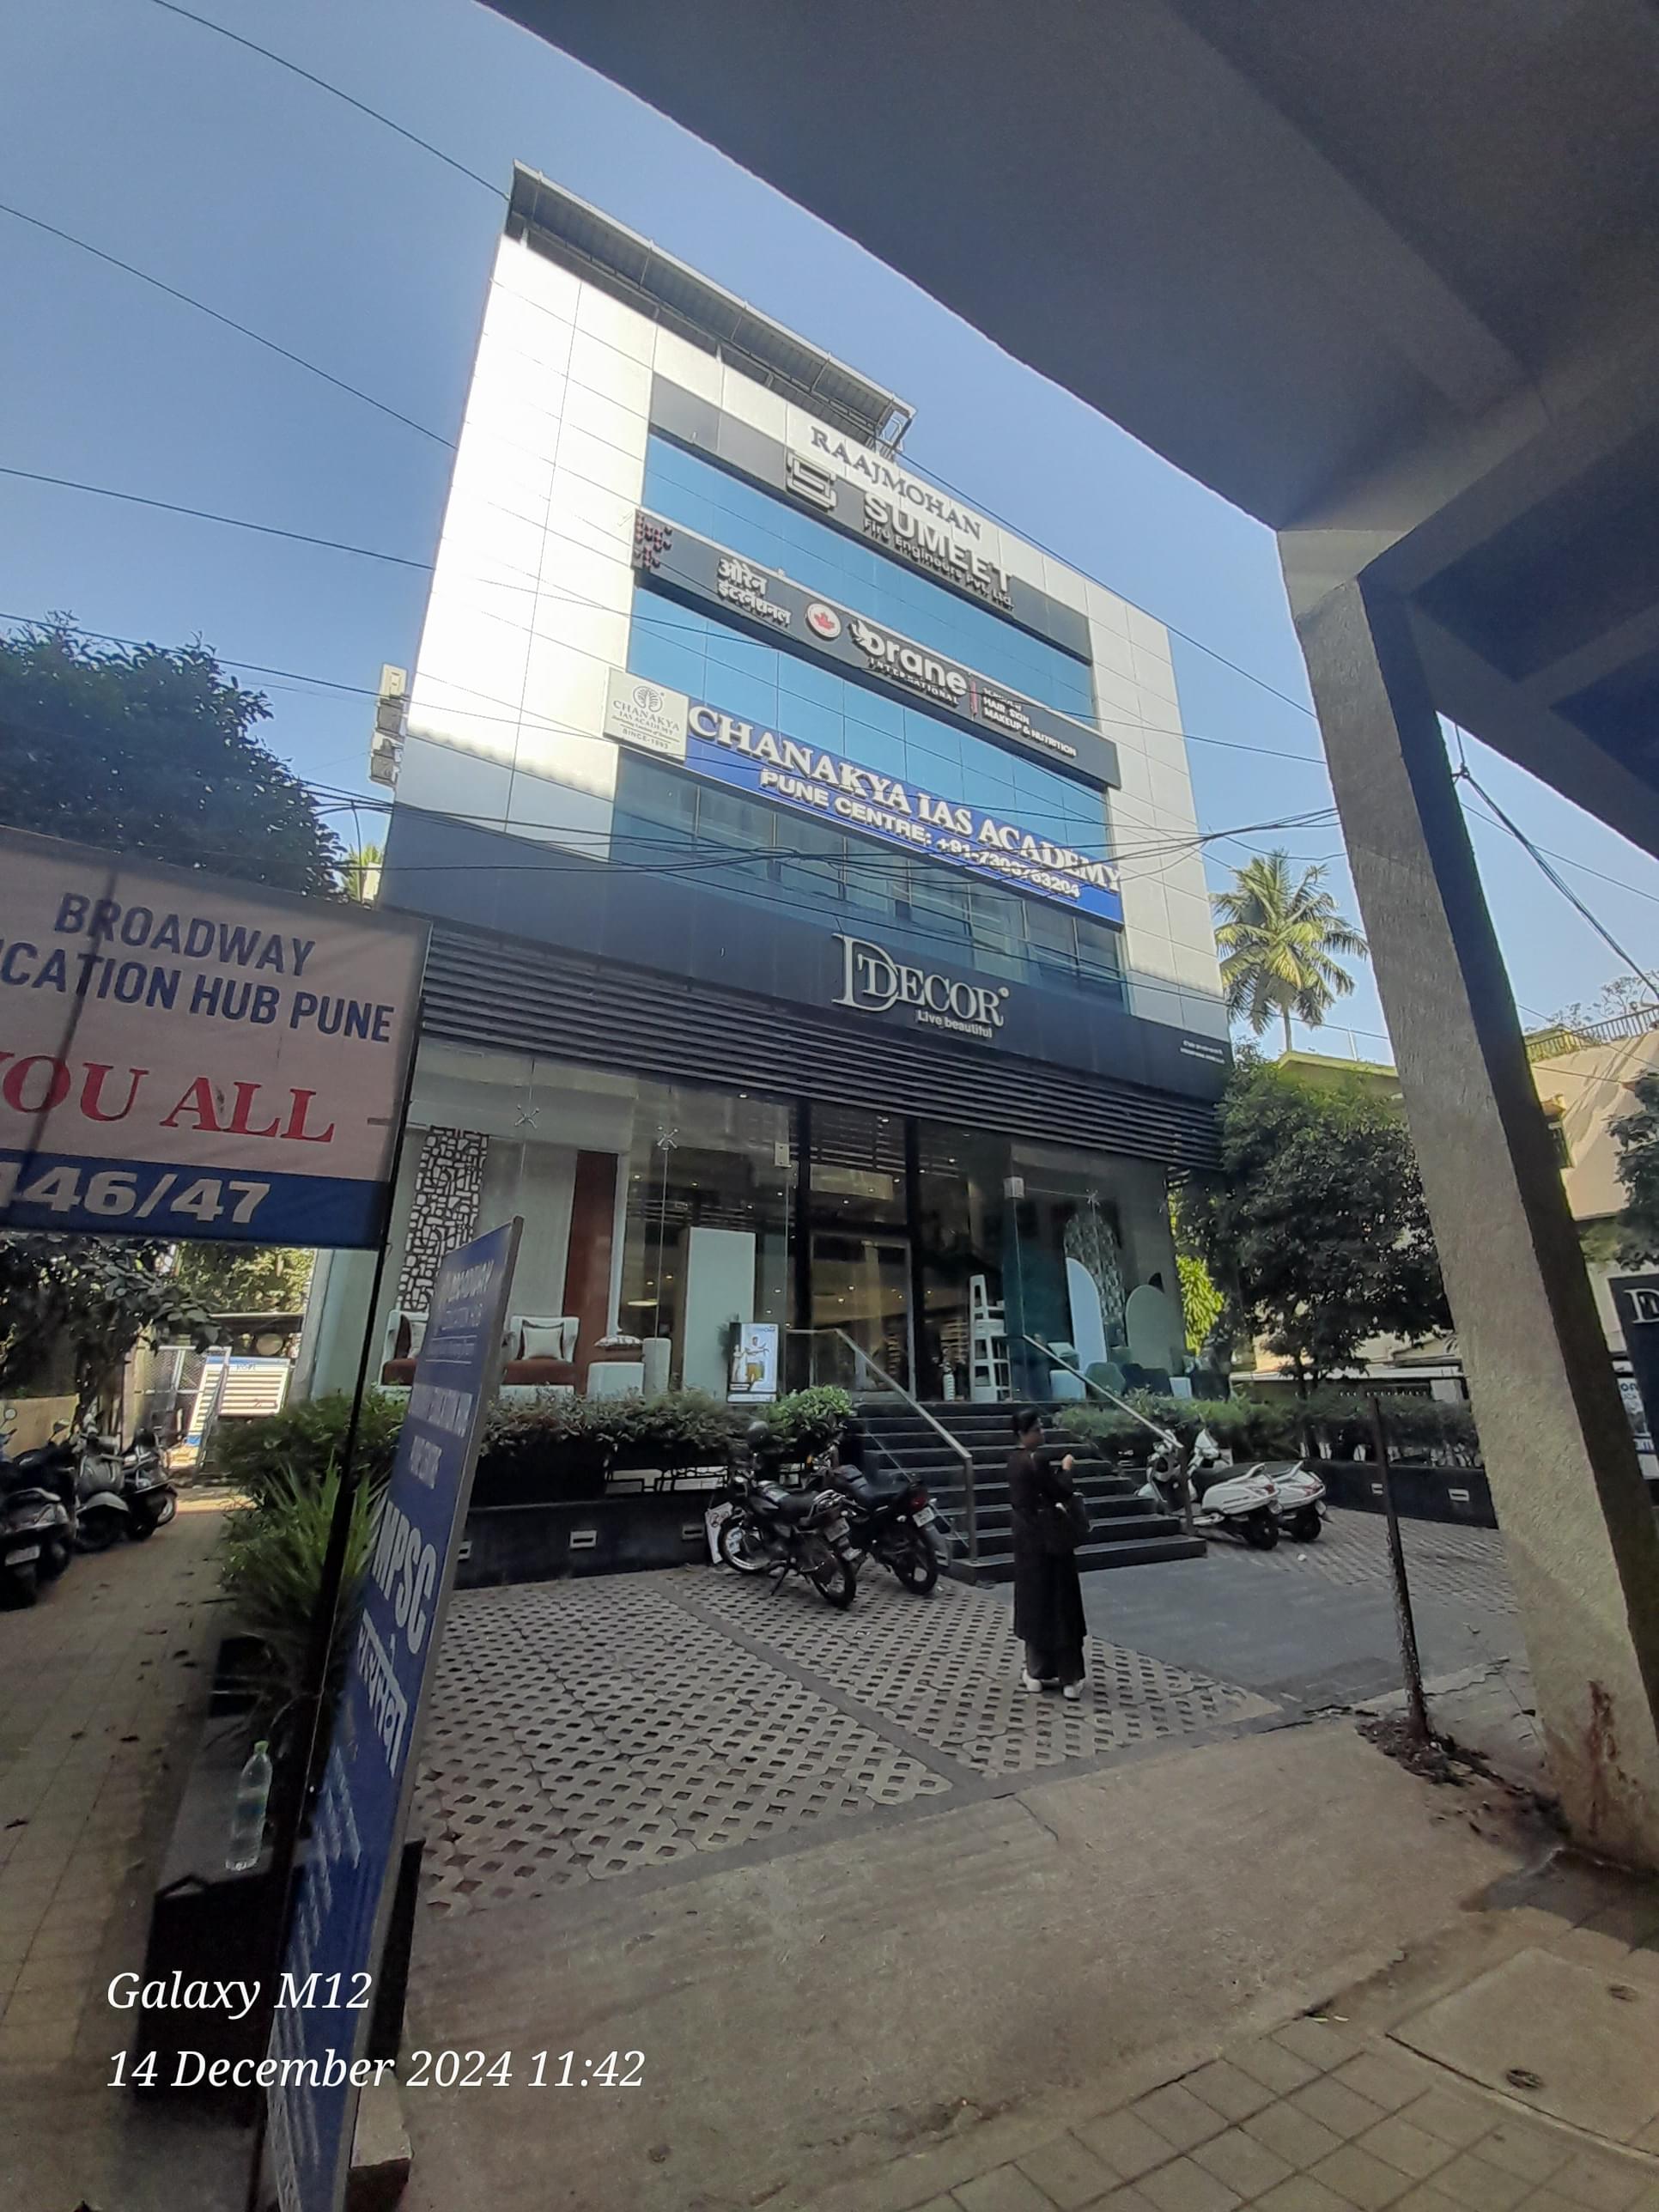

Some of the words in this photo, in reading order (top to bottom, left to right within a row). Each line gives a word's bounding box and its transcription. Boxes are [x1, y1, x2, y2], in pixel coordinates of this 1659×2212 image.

[811, 426, 981, 540] RAAJMOHAN
[864, 491, 1013, 592] SUMEET
[613, 700, 679, 732] CHANAKYA
[984, 707, 1022, 730] MAKEUP
[689, 705, 911, 815] CHANAKYA
[916, 792, 973, 836] IAS
[978, 819, 1121, 893] ACADEMY
[761, 769, 830, 807] PUNE
[834, 795, 932, 845] CENTRE:
[54, 892, 316, 977] BROADWAY
[0, 939, 181, 1010] CATION
[189, 974, 281, 1025] HUB
[289, 990, 395, 1043] PUNE
[917, 1009, 943, 1025] Live
[944, 1017, 993, 1038] beautiful
[160, 1076, 336, 1143] ALL
[371, 1499, 436, 1655] MPSC
